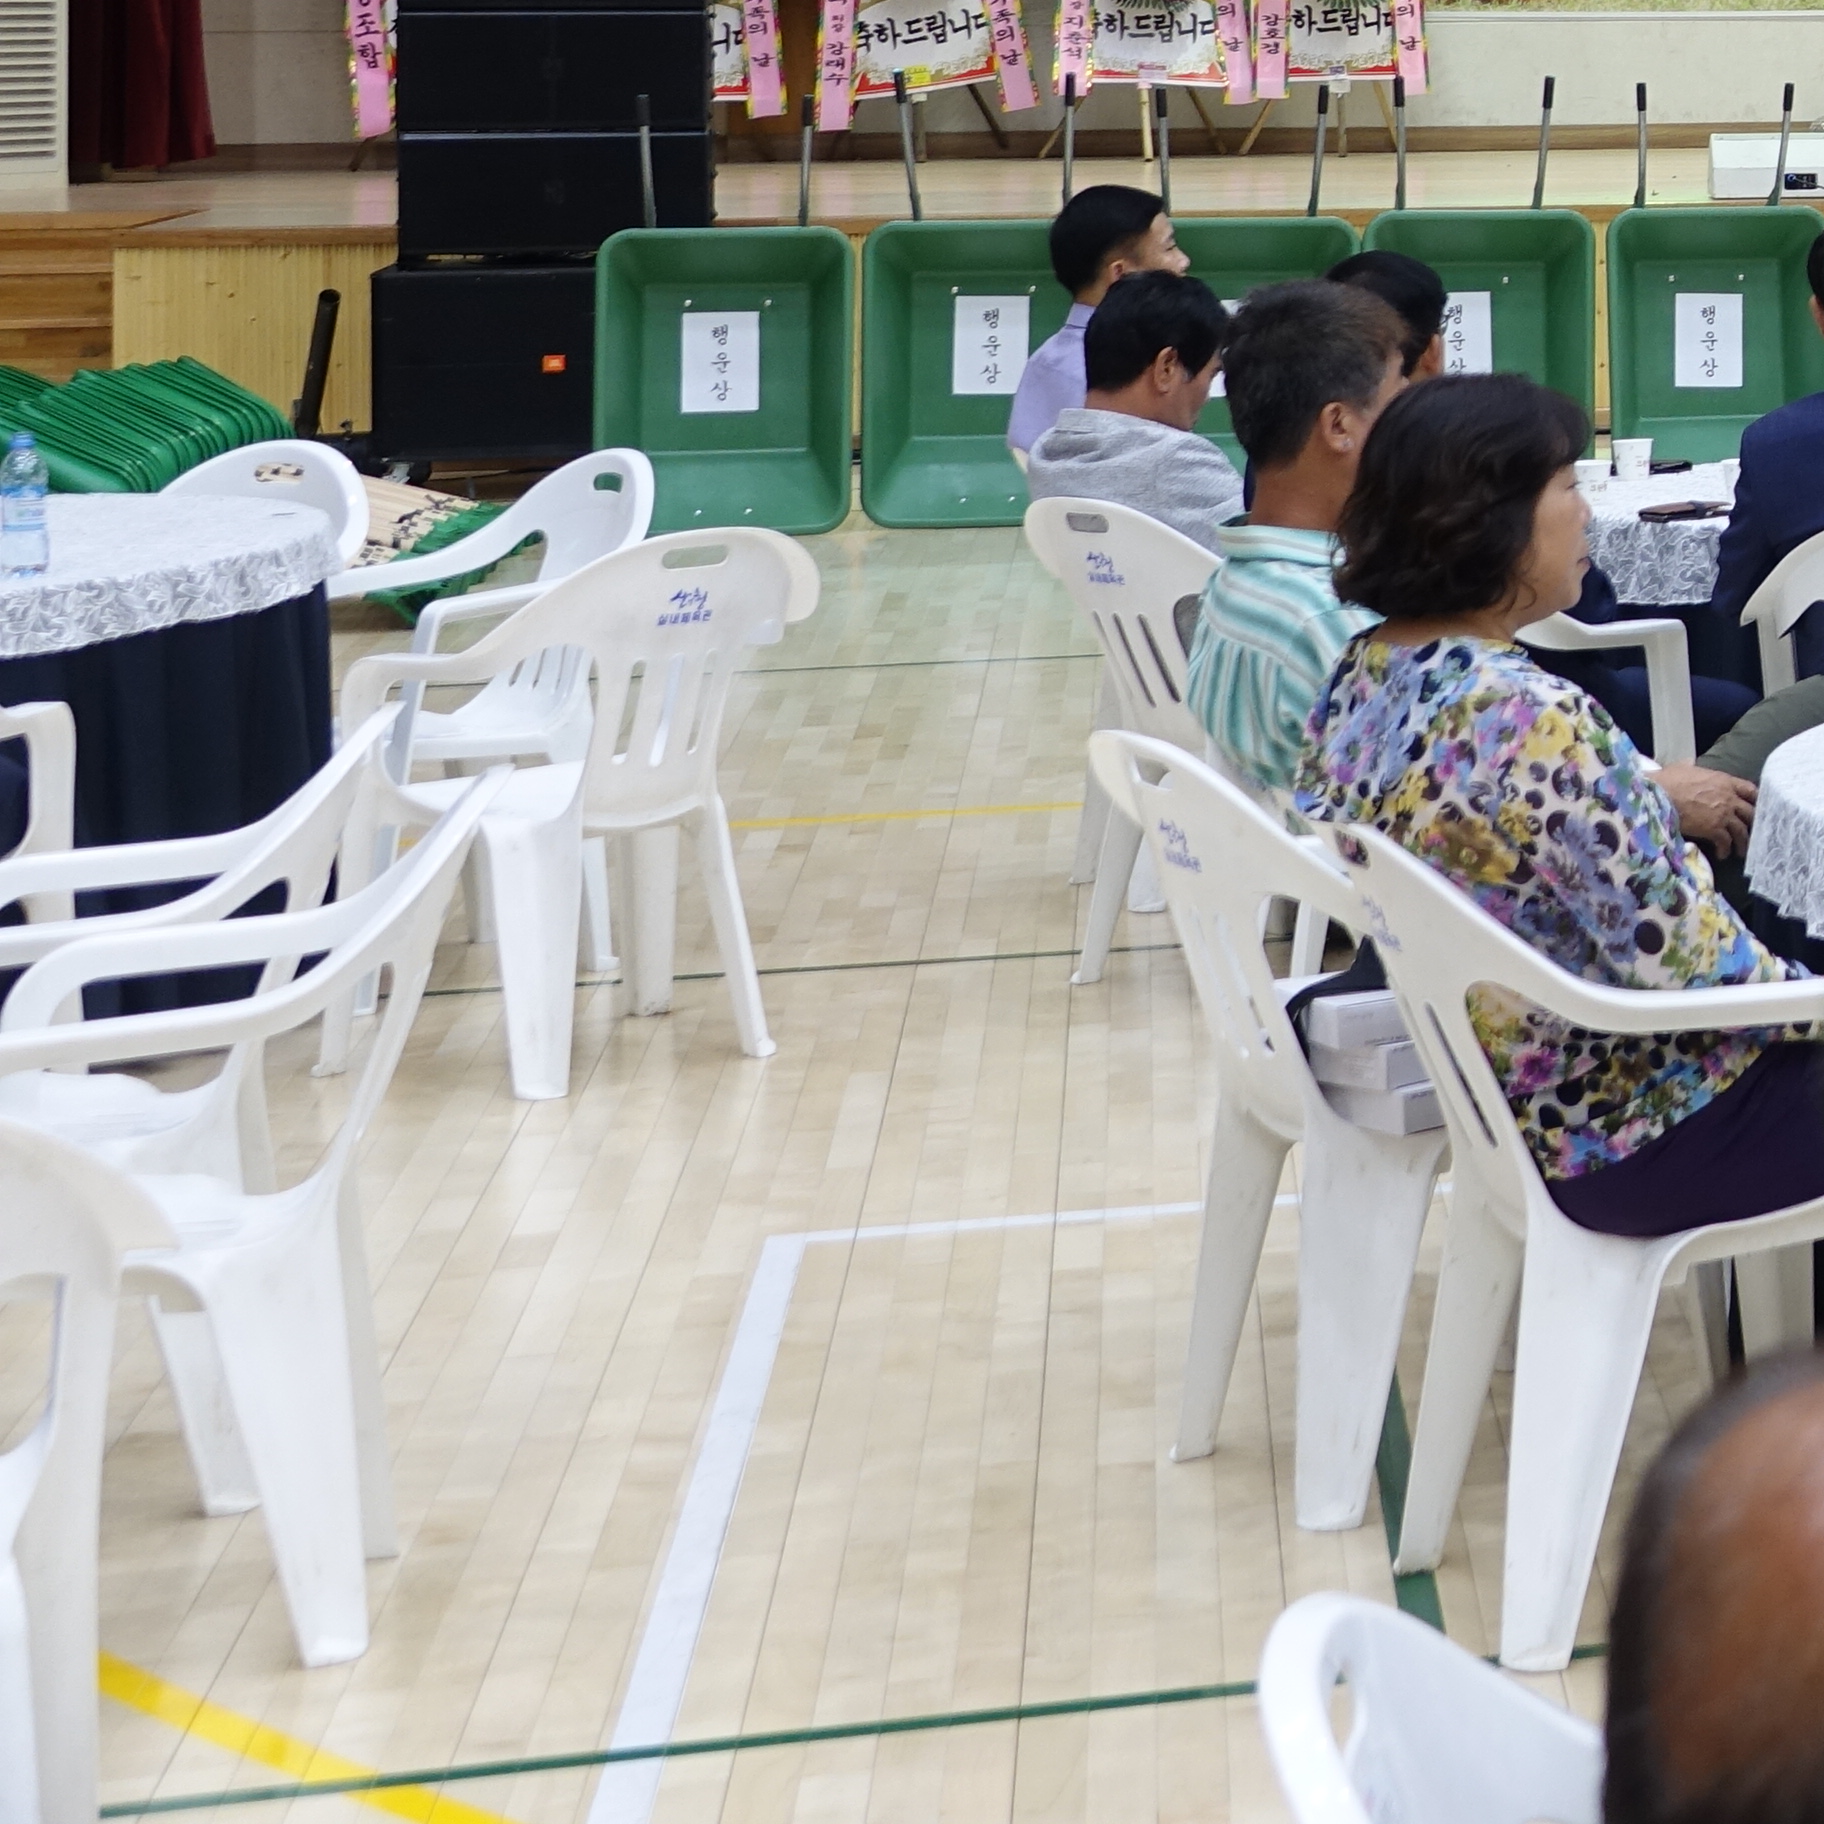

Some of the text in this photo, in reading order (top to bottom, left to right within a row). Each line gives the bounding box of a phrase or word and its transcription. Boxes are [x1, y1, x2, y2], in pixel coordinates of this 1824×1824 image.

[1094, 8, 1215, 43] 하드립니
[1288, 5, 1395, 37] 하드립니
[1001, 53, 1022, 66] 날
[710, 325, 734, 404] 행운상
[981, 307, 1003, 386] 행운상
[1700, 304, 1719, 379] 행운상
